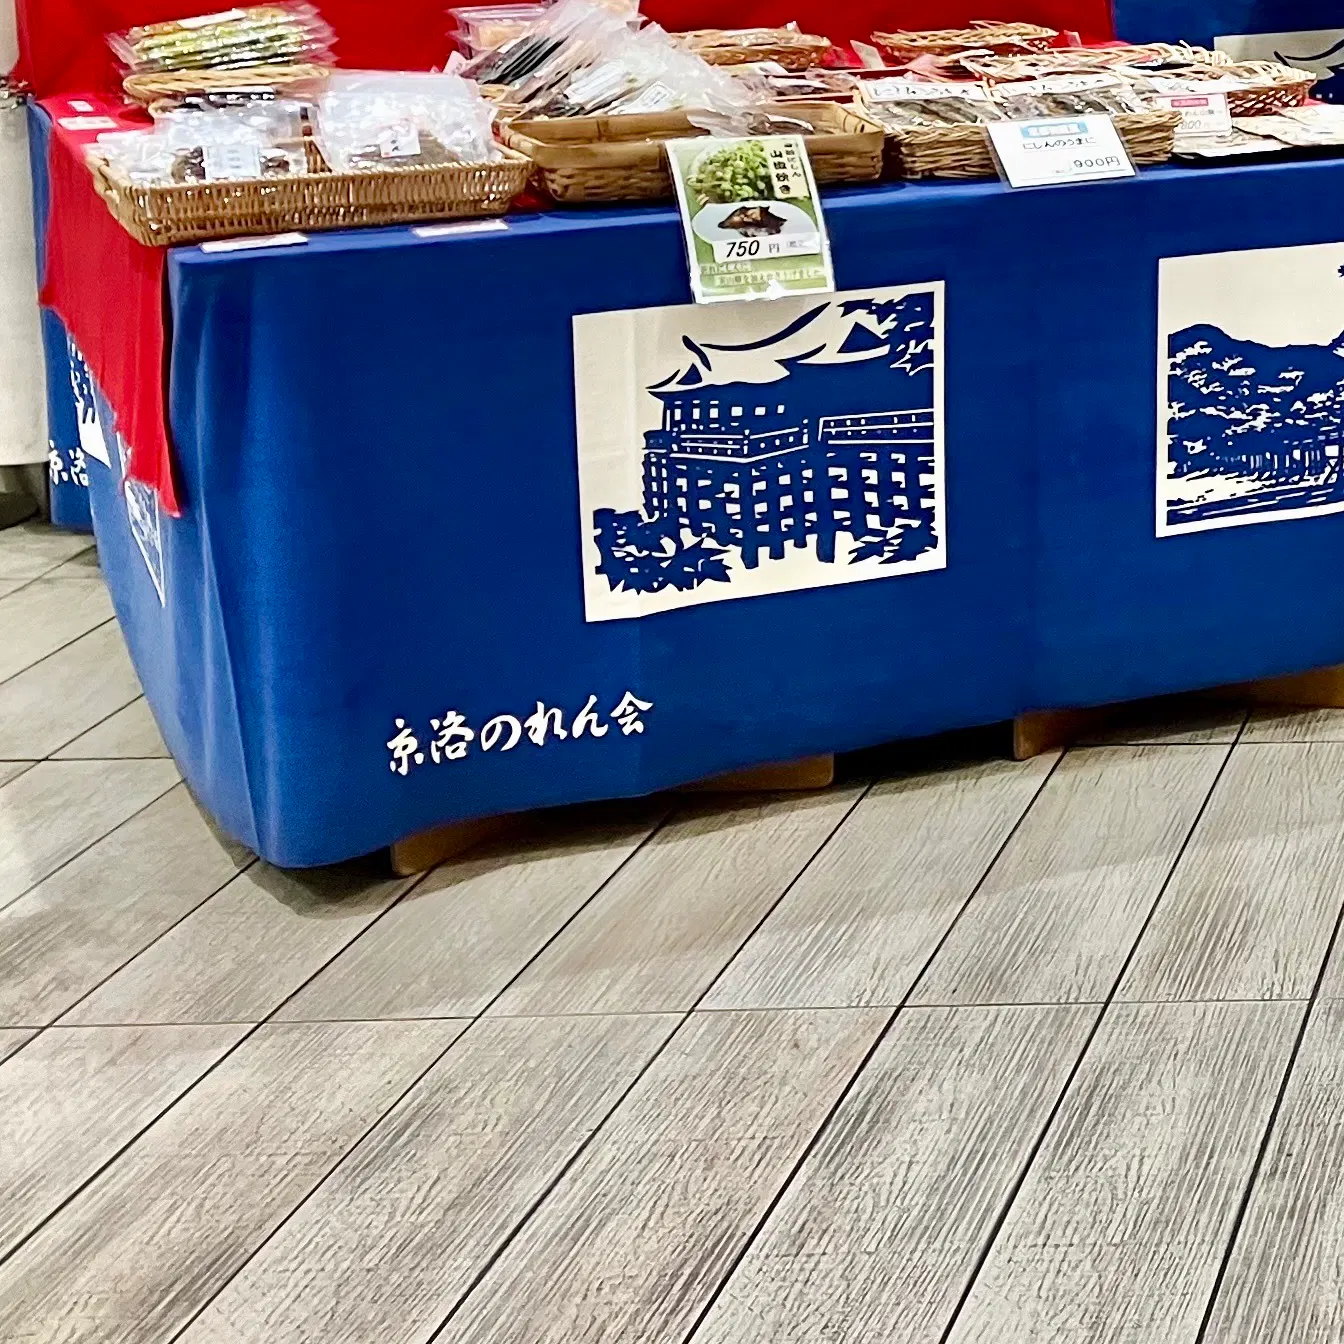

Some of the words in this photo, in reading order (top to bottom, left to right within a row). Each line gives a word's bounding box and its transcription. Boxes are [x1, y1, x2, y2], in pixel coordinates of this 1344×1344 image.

[1022, 137, 1097, 151] にしんのうまに
[1073, 156, 1121, 169] 900円
[726, 239, 760, 258] 750
[386, 691, 653, 776] 京洛のれん会
